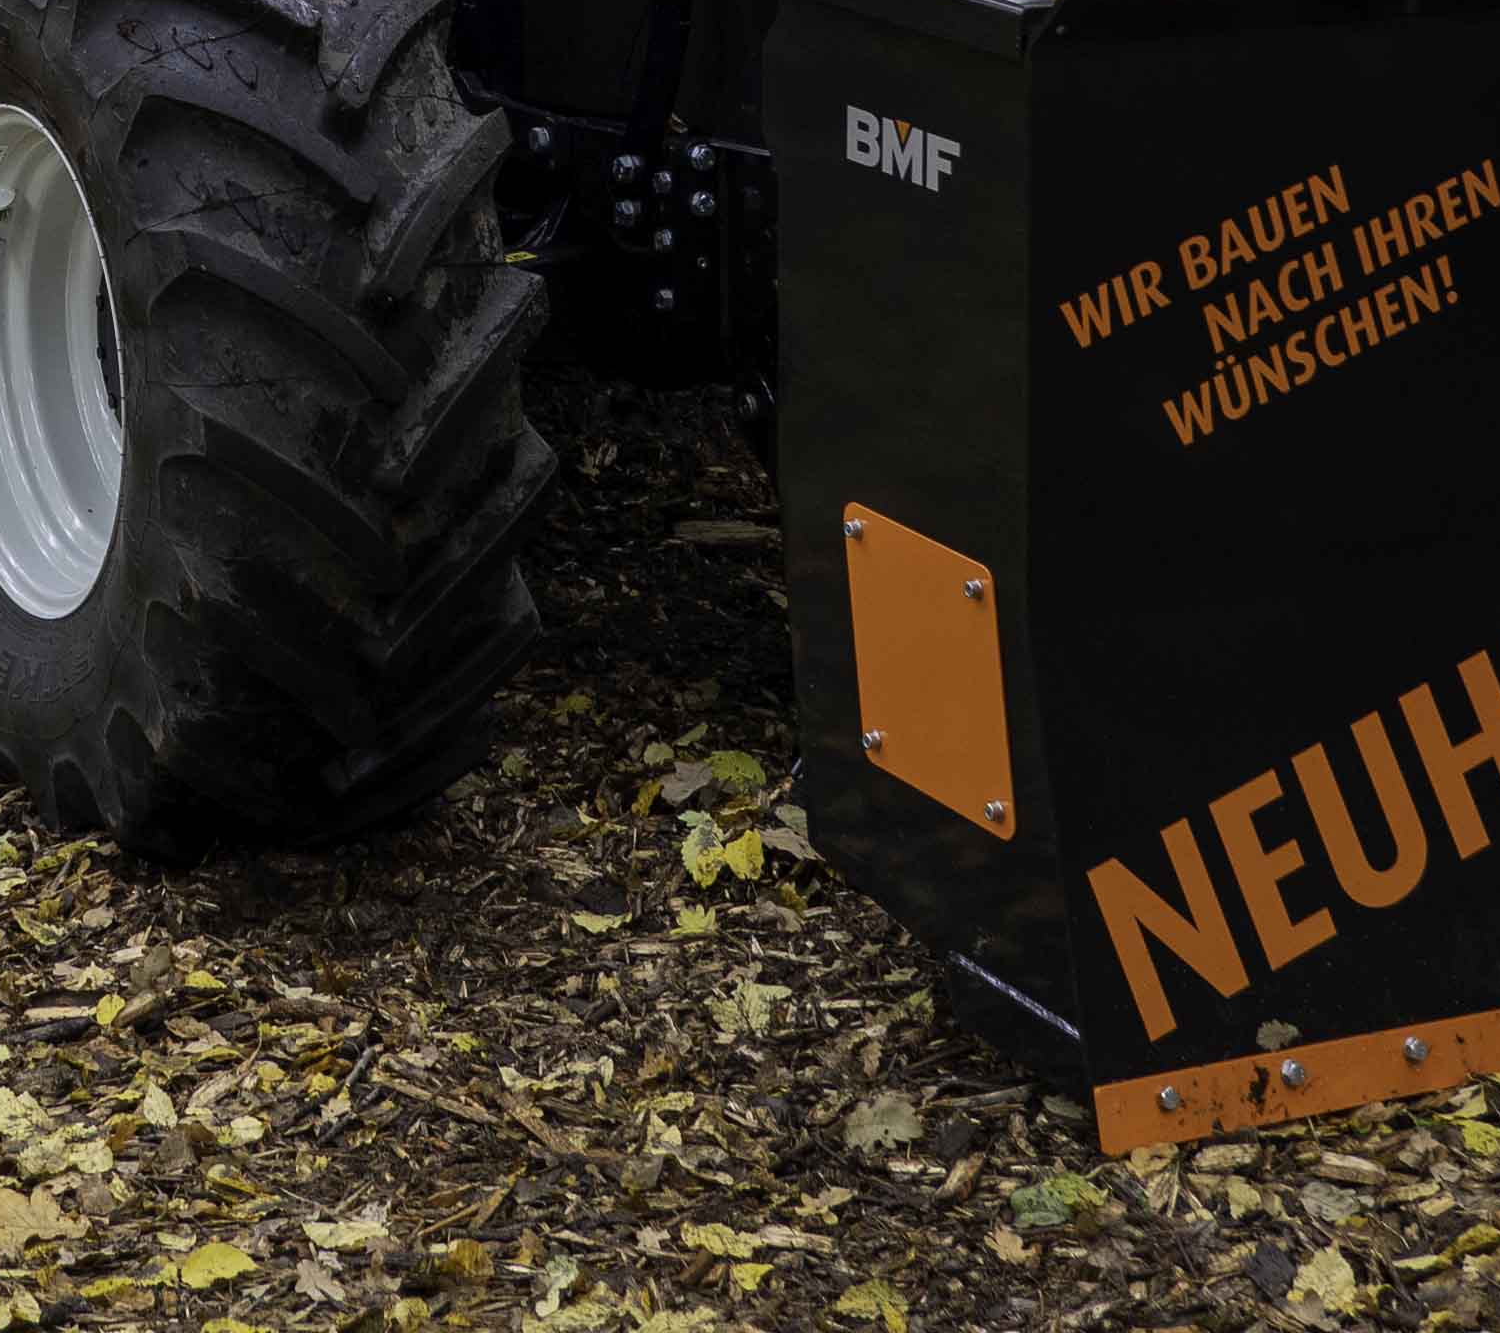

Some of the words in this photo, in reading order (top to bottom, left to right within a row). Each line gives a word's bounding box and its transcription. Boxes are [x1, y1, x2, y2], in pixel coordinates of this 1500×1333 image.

[846, 105, 961, 192] BMF
[1060, 259, 1172, 349] WIR
[1178, 164, 1351, 291] BAUEN
[1203, 241, 1345, 354] NACH
[1162, 255, 1459, 446] WÜNSCHEN!
